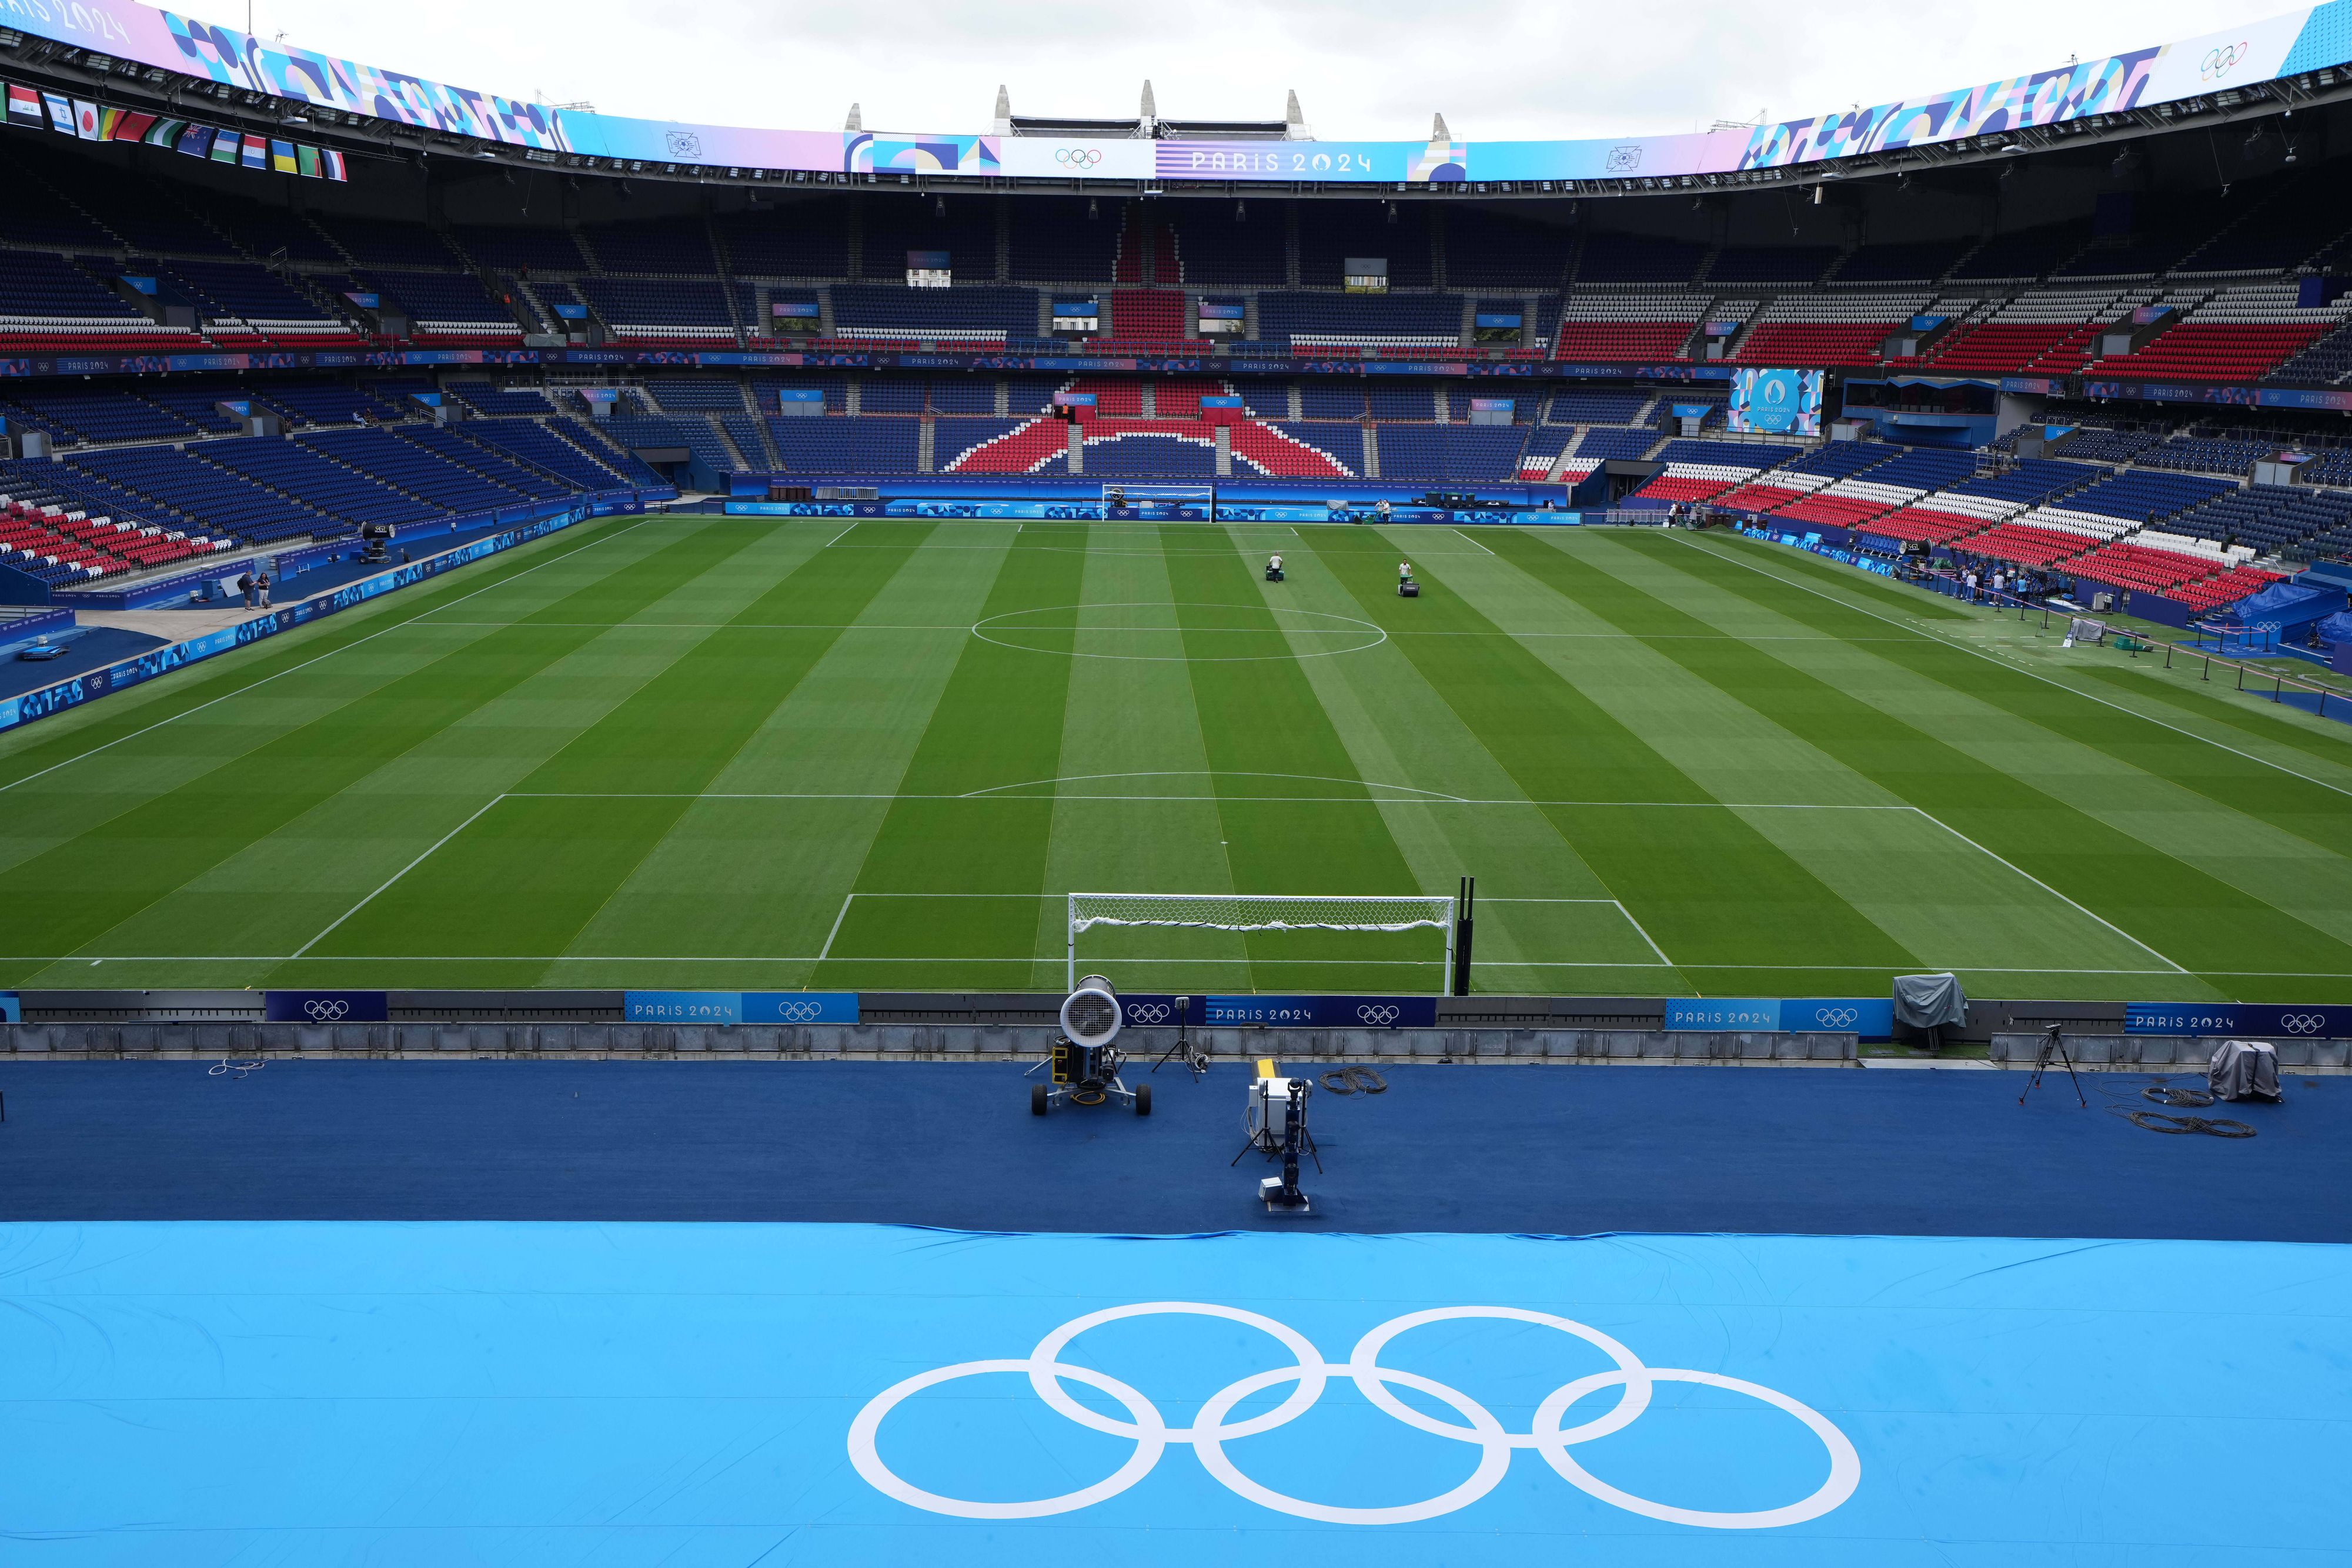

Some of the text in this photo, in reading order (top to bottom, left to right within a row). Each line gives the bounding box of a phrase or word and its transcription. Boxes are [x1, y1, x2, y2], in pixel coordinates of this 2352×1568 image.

[1192, 152, 1371, 172] PARIS 2024
[635, 1005, 731, 1017] PARIS 2024
[1216, 1009, 1311, 1020] PARIS 2024
[1675, 1012, 1770, 1023] PARIS 2024
[2136, 1017, 2233, 1028] PARIS 2024
